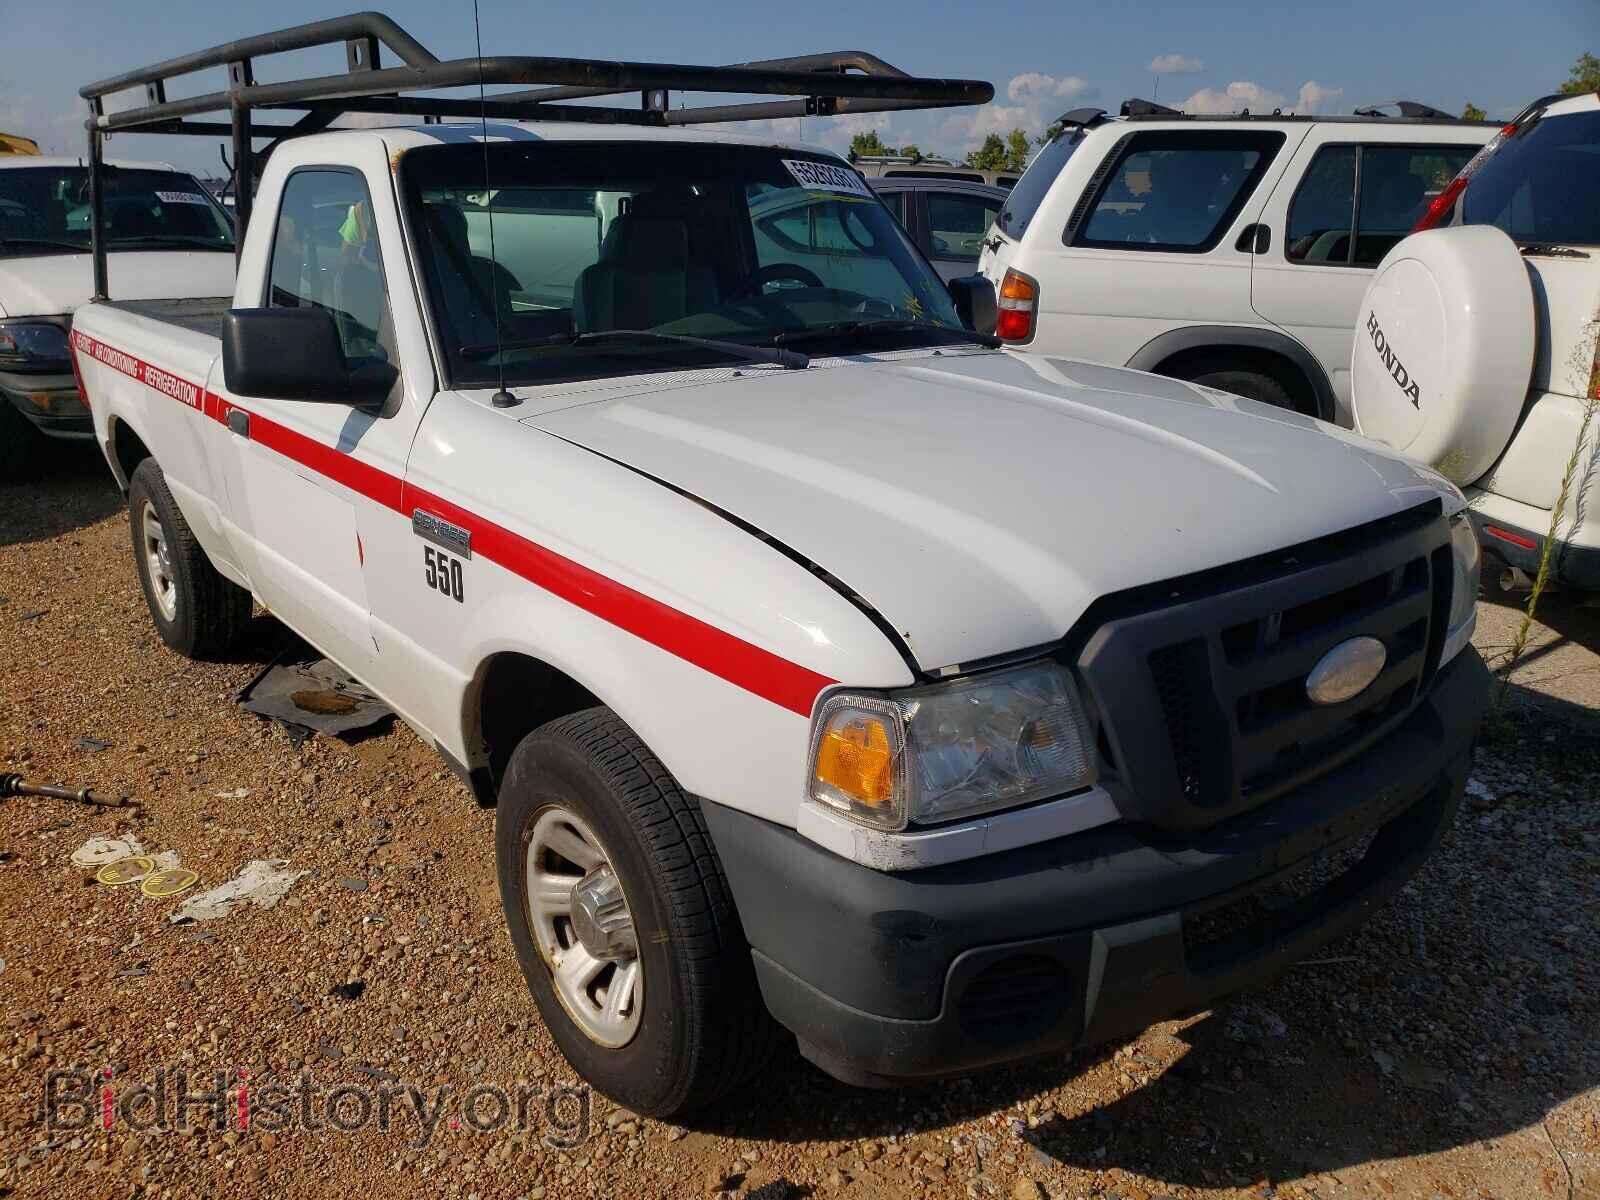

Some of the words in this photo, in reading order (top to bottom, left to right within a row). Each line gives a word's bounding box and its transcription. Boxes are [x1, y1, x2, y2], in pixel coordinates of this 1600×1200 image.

[102, 346, 138, 378] CONDITIONING
[144, 365, 198, 406] REFRIGERATION
[1366, 310, 1420, 410] HONDA
[423, 545, 464, 603] 550
